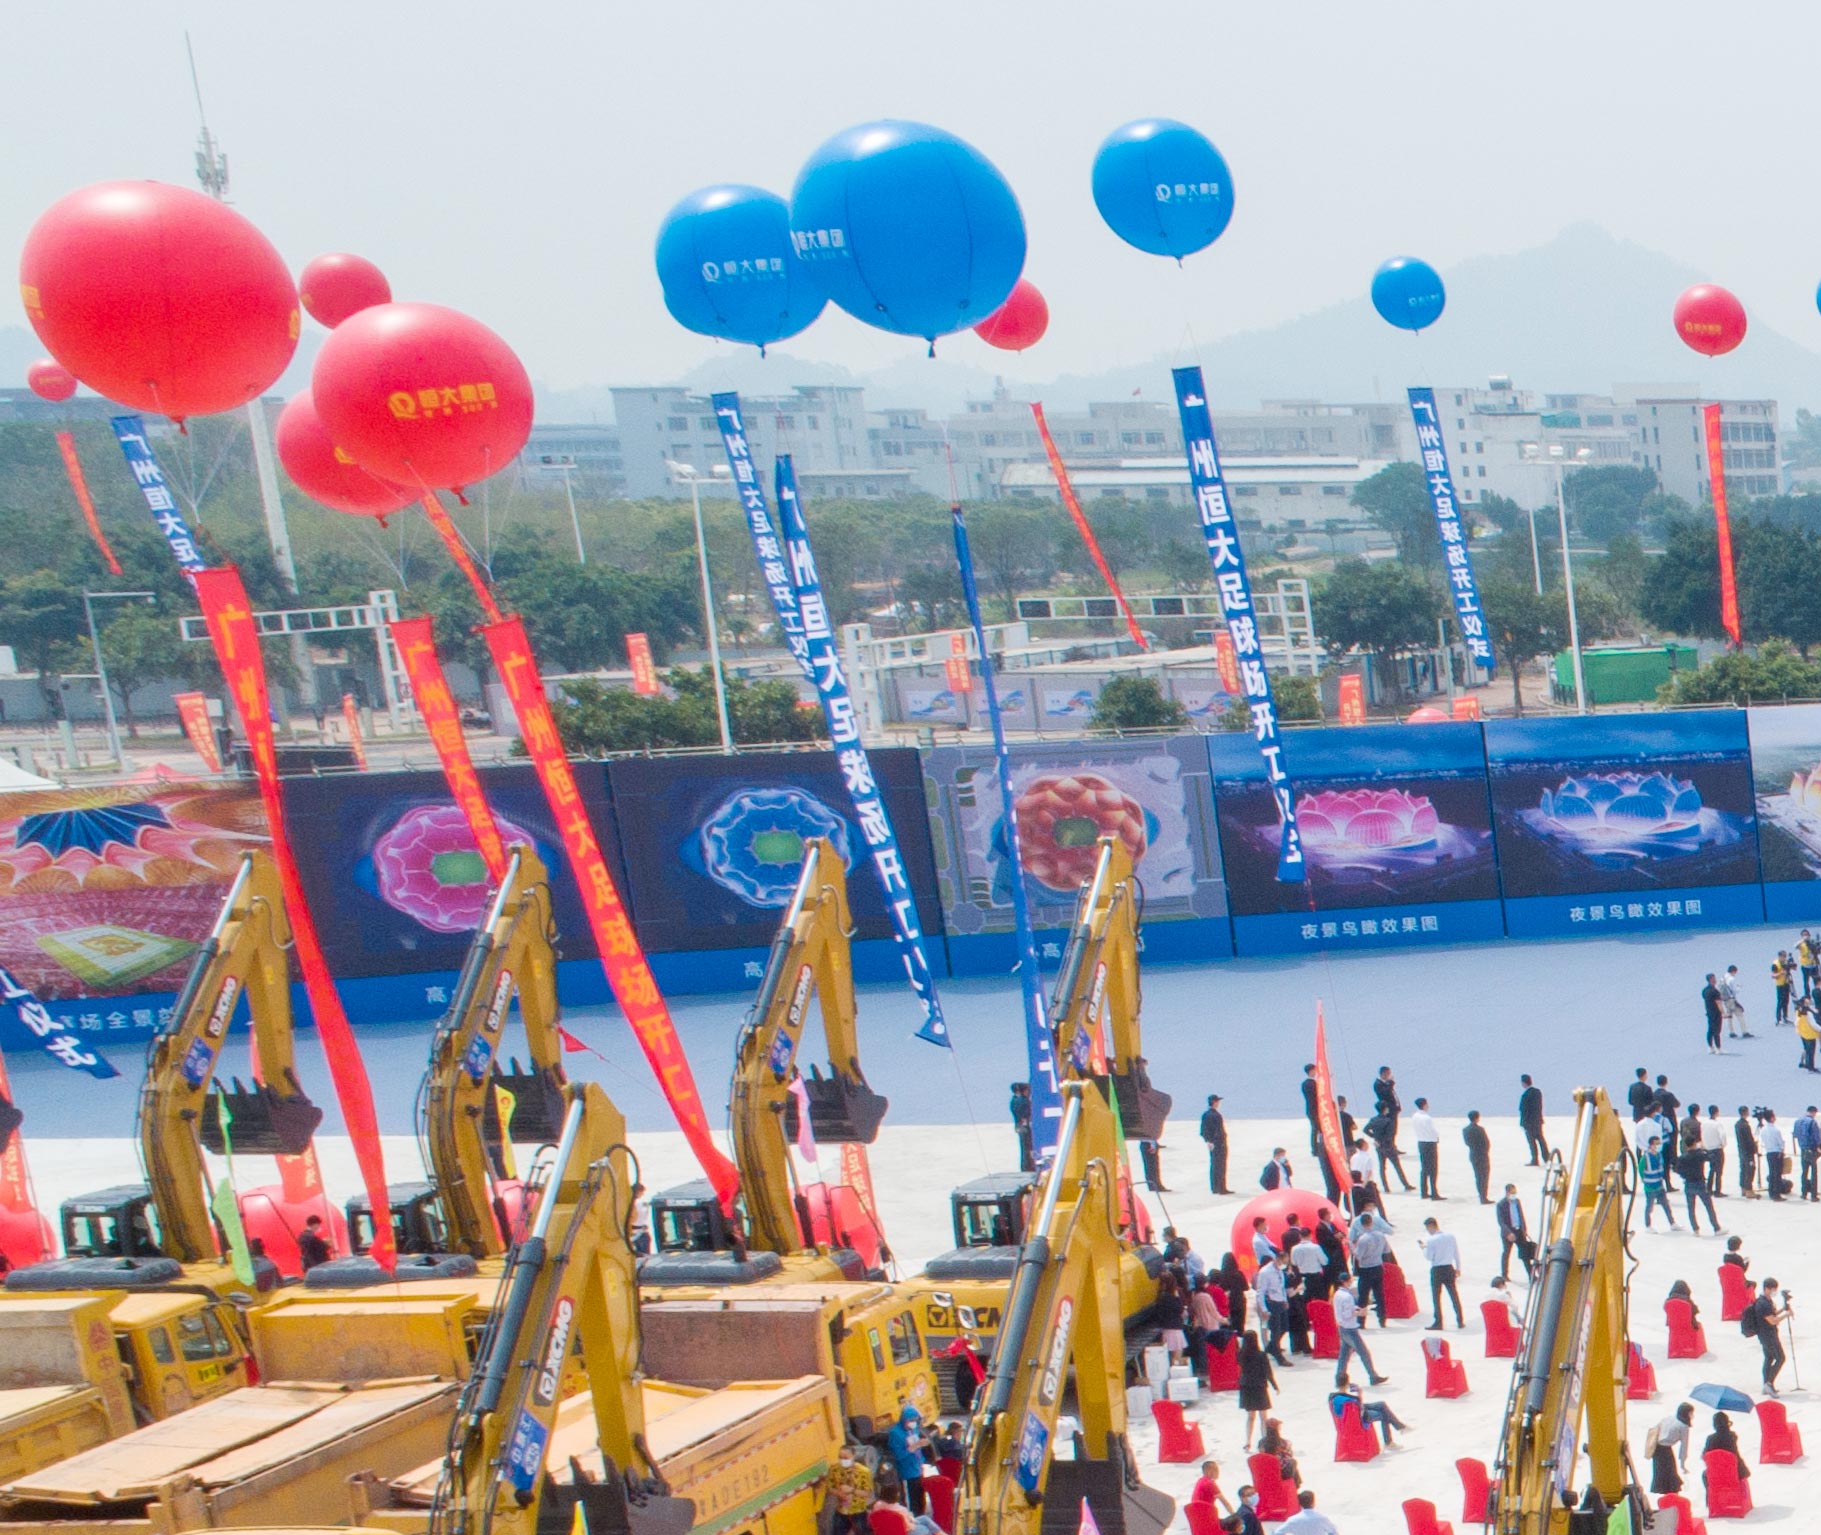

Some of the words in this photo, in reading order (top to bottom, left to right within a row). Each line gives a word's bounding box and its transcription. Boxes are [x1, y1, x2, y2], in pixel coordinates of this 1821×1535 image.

[1174, 182, 1219, 196] 恒大集团
[726, 257, 783, 274] 恒大集团
[1569, 898, 1703, 923] 夜景鸟瞰效果图
[1301, 915, 1439, 940] 夜景鸟瞰效果图
[546, 1298, 573, 1372] XCMG
[1049, 1300, 1072, 1373] XCMG
